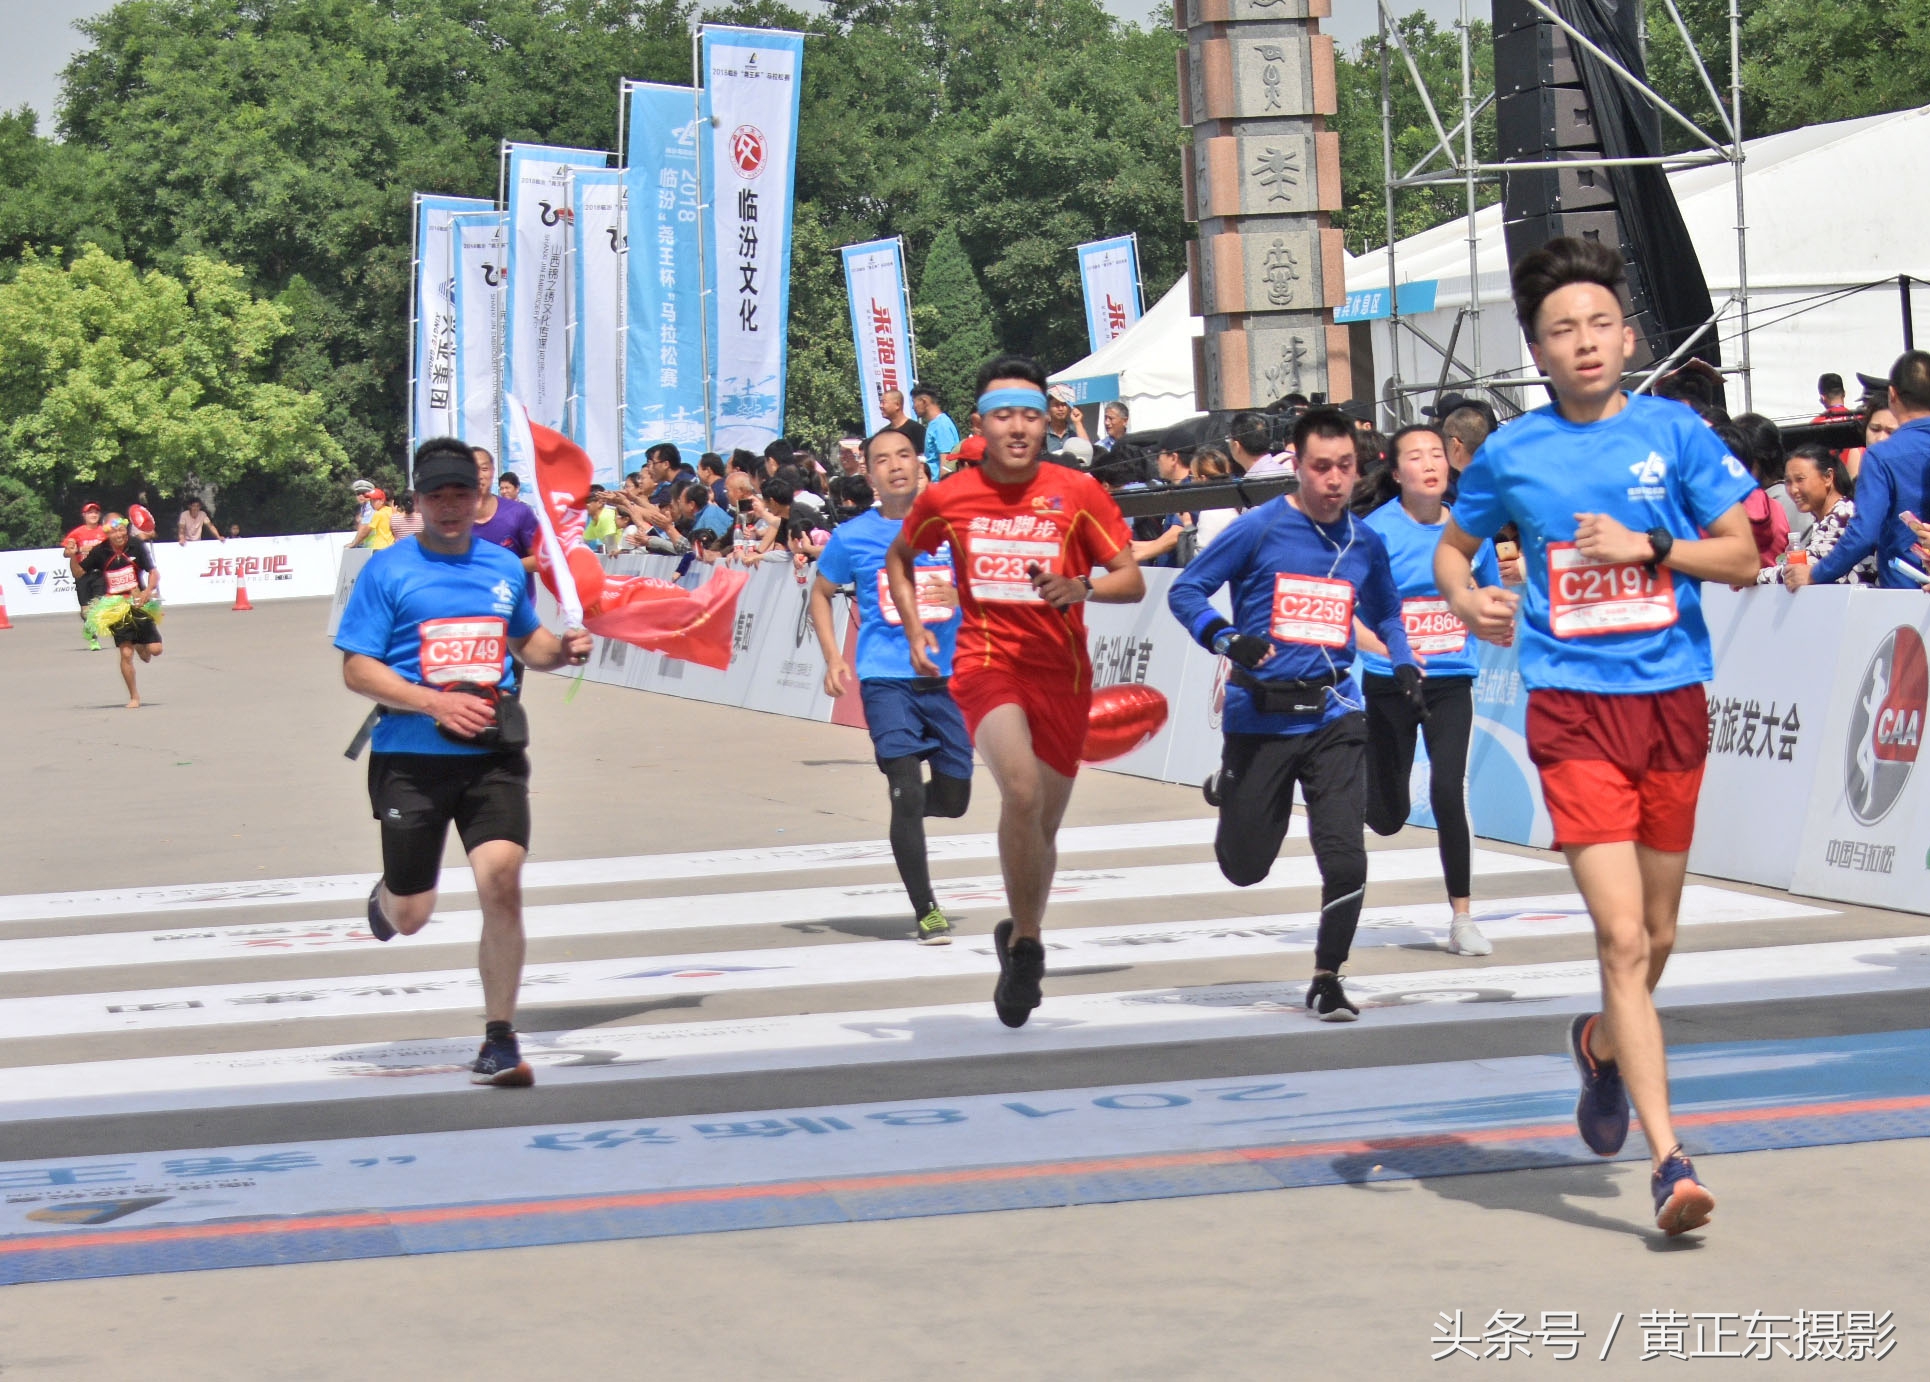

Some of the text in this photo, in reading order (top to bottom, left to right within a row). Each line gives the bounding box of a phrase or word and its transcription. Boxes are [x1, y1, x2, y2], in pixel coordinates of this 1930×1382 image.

[738, 188, 759, 332] 临汾文化
[430, 314, 457, 410] 兴业集团
[199, 555, 294, 577] 来跑吧
[1280, 595, 1347, 622] C2259
[429, 639, 500, 663] C3749
[1091, 635, 1153, 689] 临汾体育
[1877, 708, 1920, 746] CAA
[1825, 839, 1897, 874] 中国马拉松
